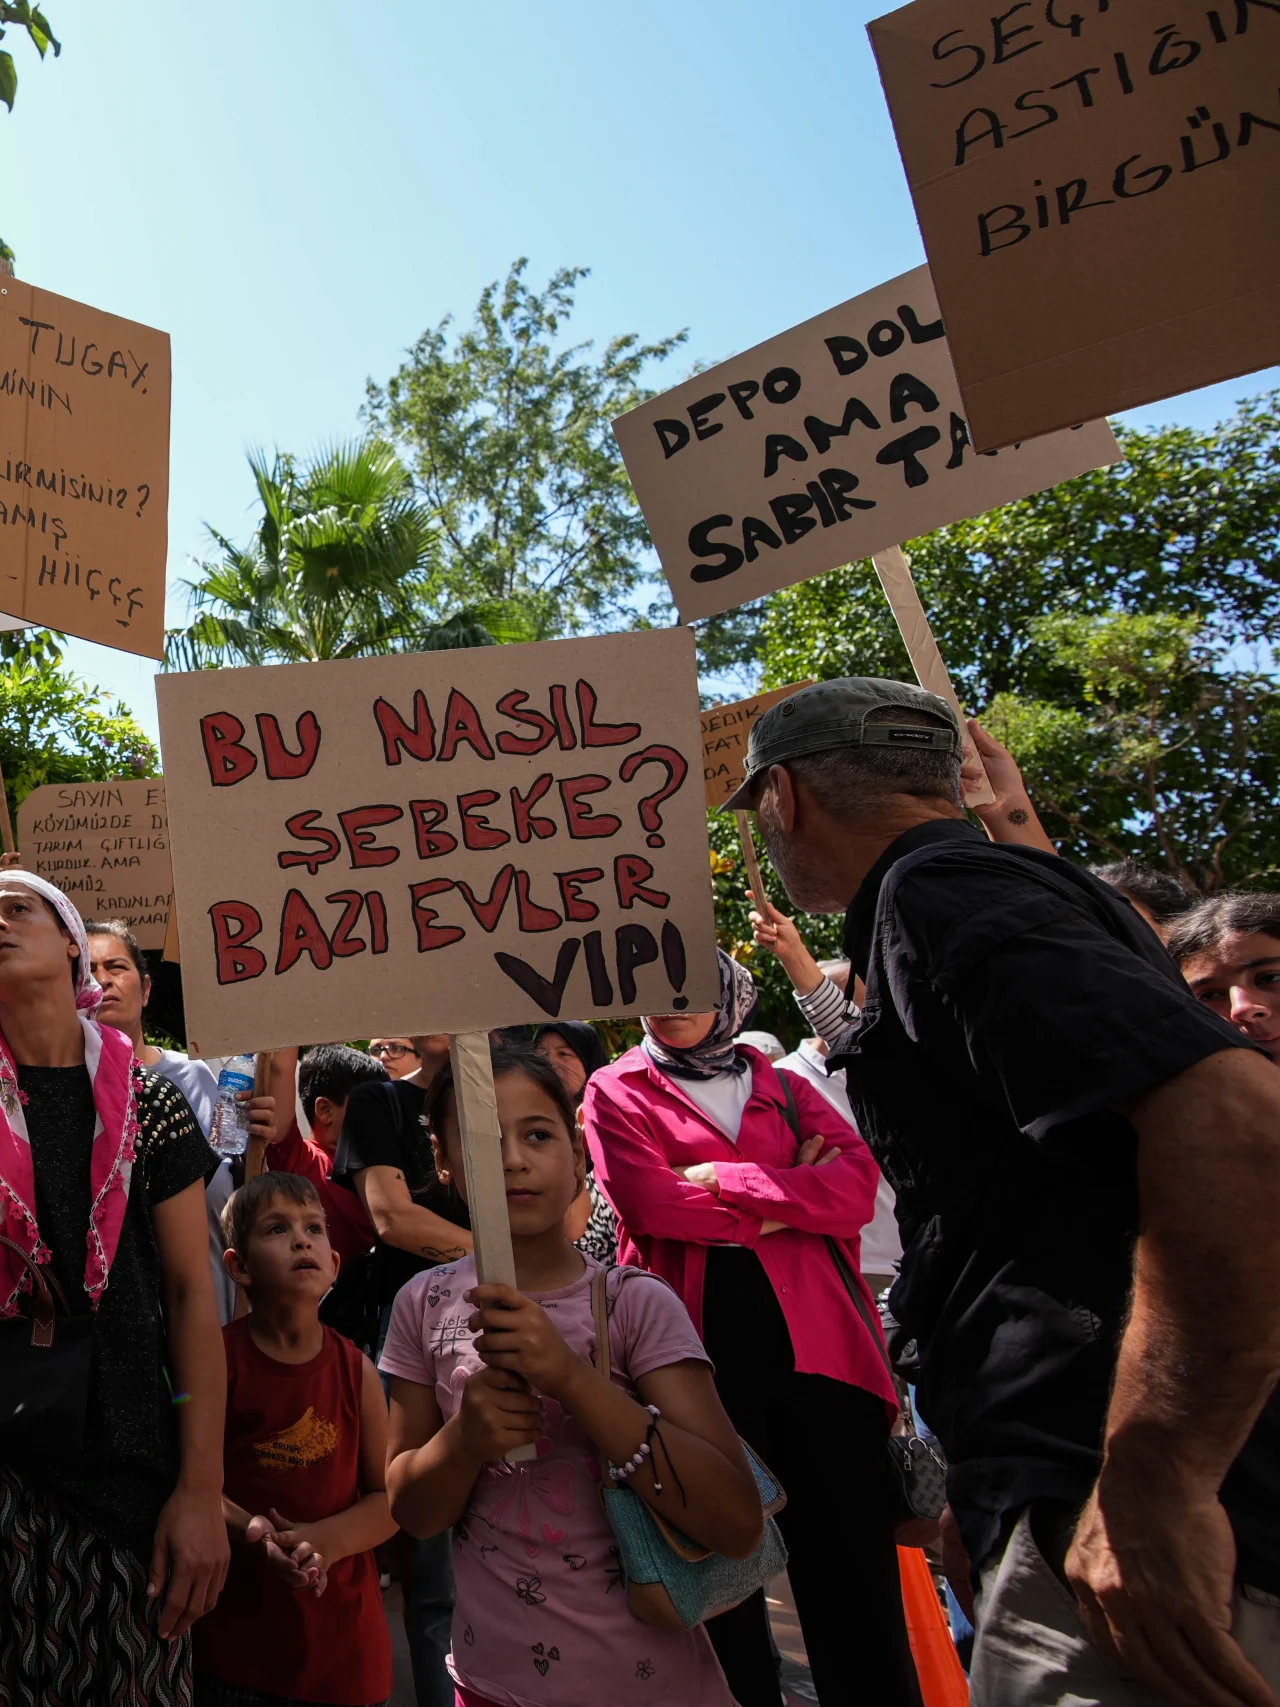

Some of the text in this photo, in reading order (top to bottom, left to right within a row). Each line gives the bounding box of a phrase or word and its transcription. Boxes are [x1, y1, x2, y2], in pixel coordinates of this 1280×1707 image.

[930, 0, 1109, 88] SEÇ
[653, 304, 946, 459] DEPO DOL
[763, 373, 940, 478] AMA
[687, 412, 1020, 584] SABIR TA
[200, 679, 641, 787] BU NASIL
[33, 813, 132, 833] KÖYÜMÜZDE
[33, 839, 82, 854] TARIM
[57, 788, 166, 808] SAYIN E
[277, 744, 688, 875] ŞEBEKE?
[101, 856, 140, 870] AMA
[209, 854, 670, 985] BAZI EVLER
[494, 919, 689, 1017] VIP!
